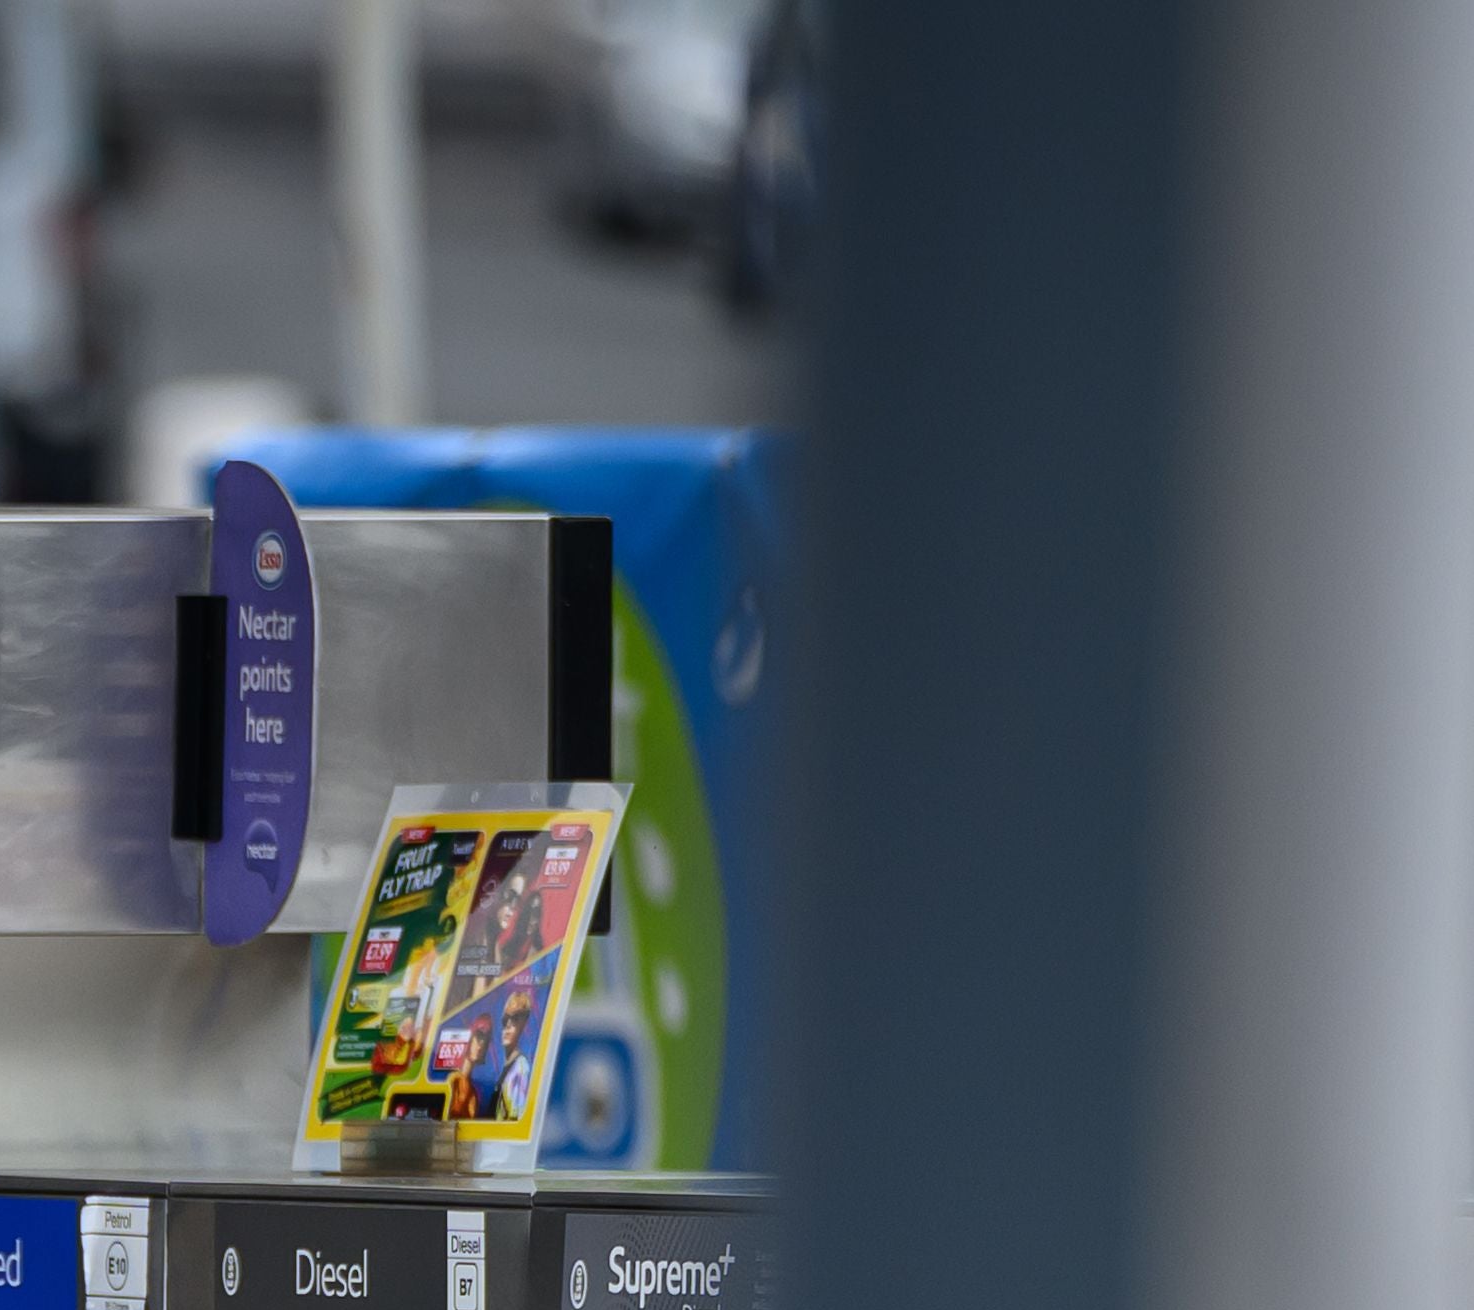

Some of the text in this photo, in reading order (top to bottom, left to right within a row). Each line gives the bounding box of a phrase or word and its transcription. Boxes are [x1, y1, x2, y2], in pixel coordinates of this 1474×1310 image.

[260, 547, 283, 570] Esso
[239, 605, 297, 641] Nectar
[240, 655, 293, 701] points
[245, 706, 284, 745] here
[395, 842, 439, 874] FRUIT
[379, 864, 443, 902] FLY TRAP
[104, 1211, 132, 1229] Petrol
[451, 1235, 481, 1254] Diesel
[108, 1257, 127, 1275] E10
[295, 1248, 368, 1298] Diesel
[459, 1278, 474, 1297] B7
